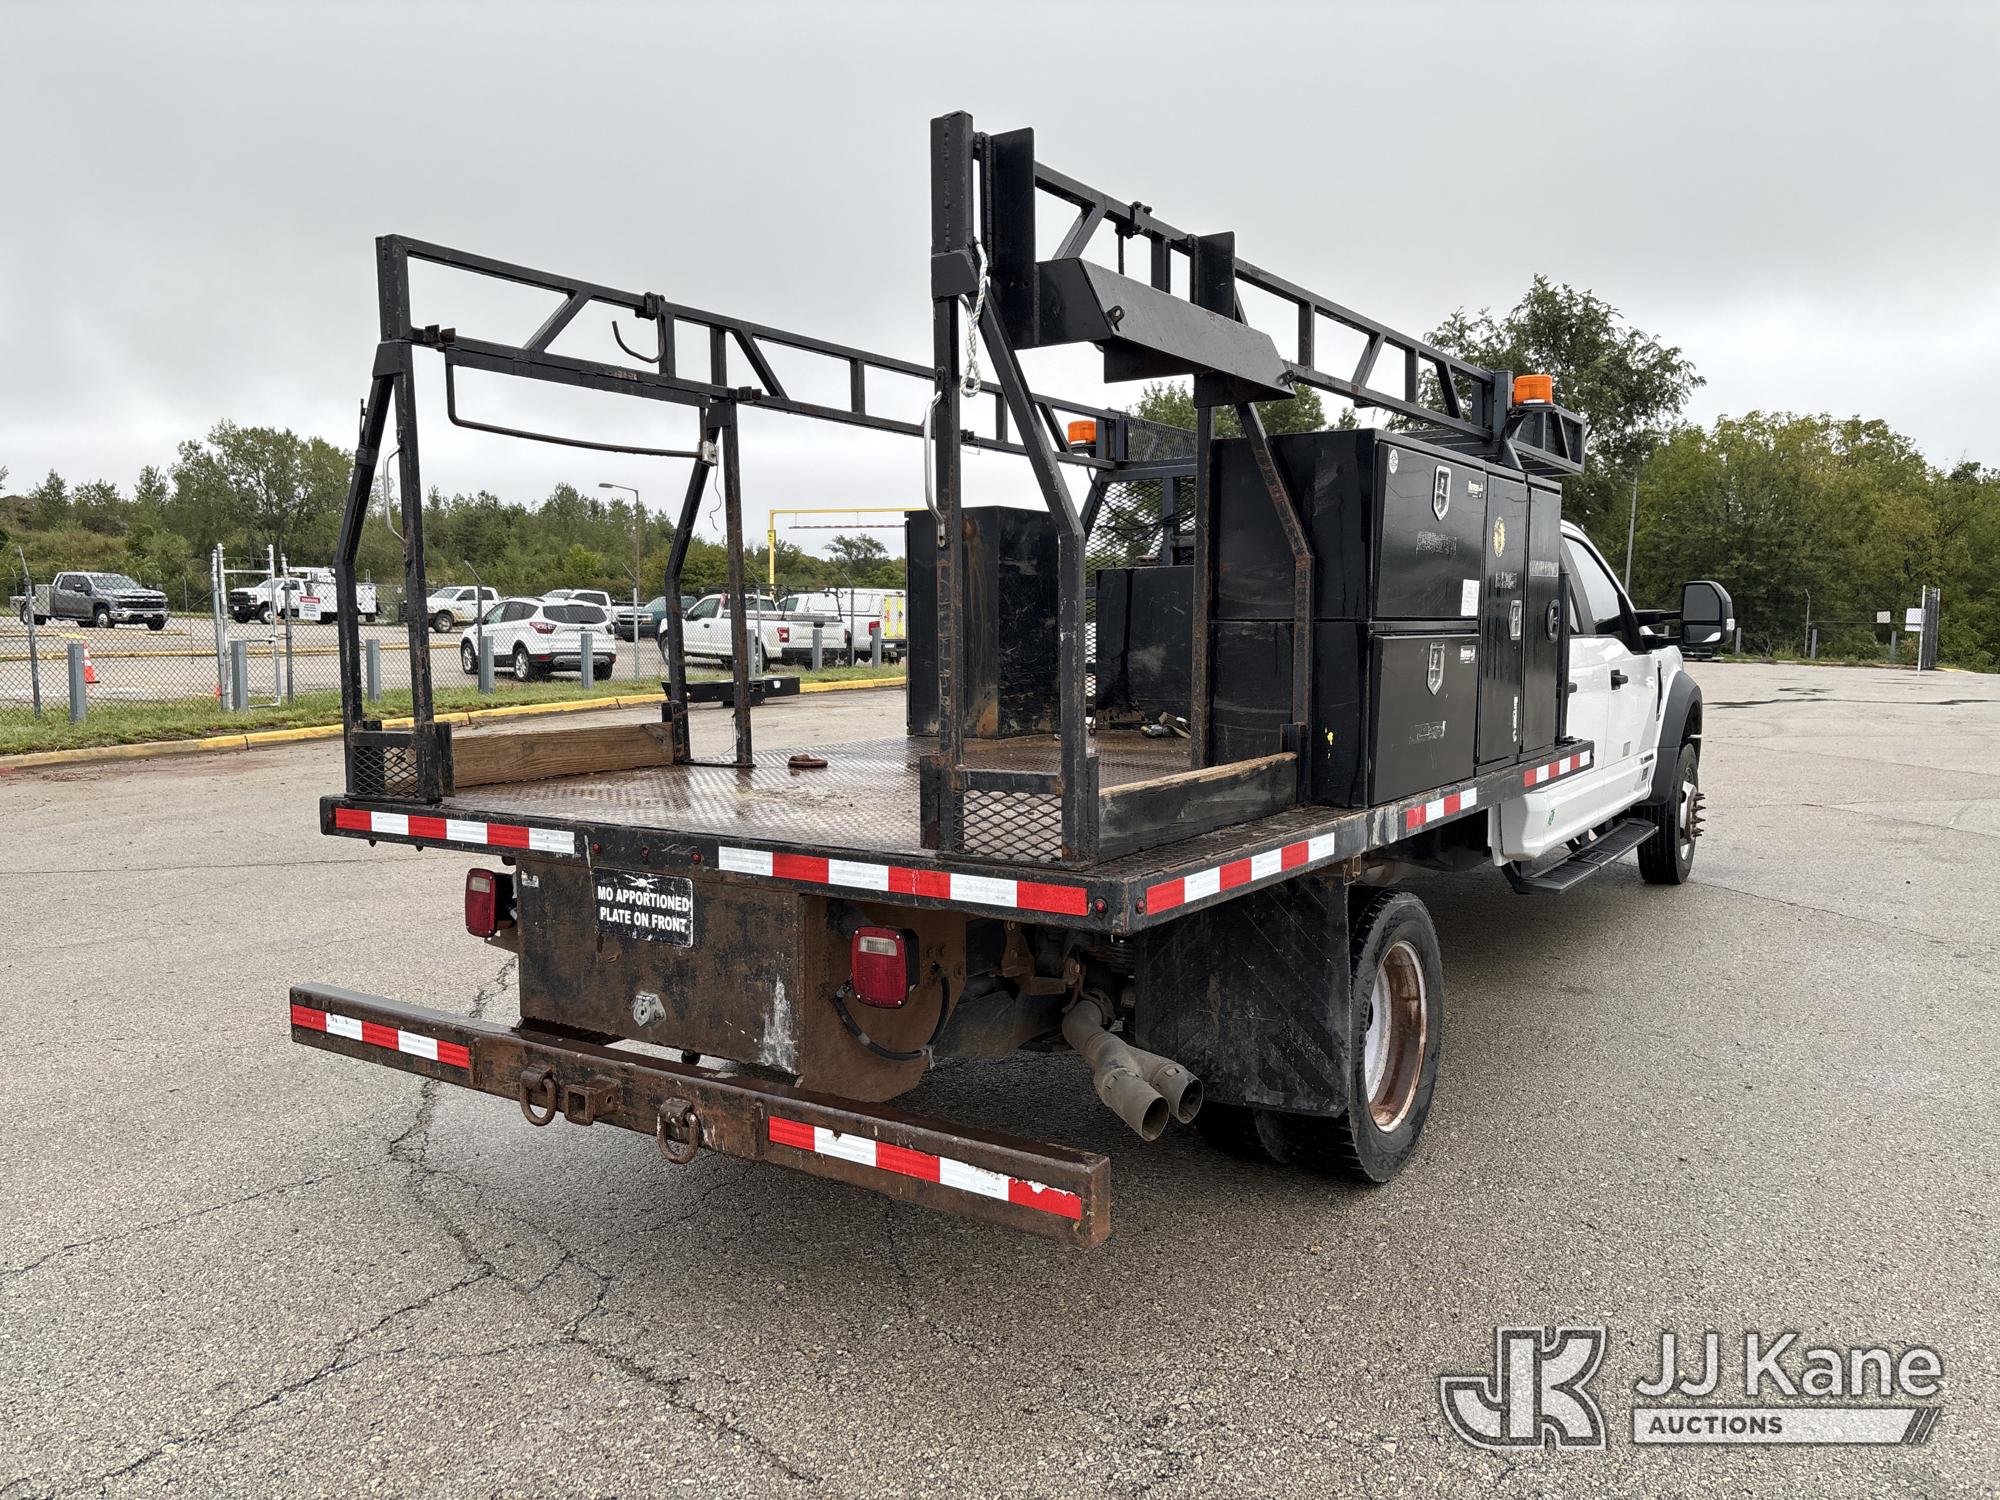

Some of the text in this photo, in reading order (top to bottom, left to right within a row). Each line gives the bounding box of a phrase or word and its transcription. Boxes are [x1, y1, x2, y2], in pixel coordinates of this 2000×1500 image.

[597, 886, 689, 911] MO APPORTIONED
[600, 906, 687, 932] PLATE ON FRONT
